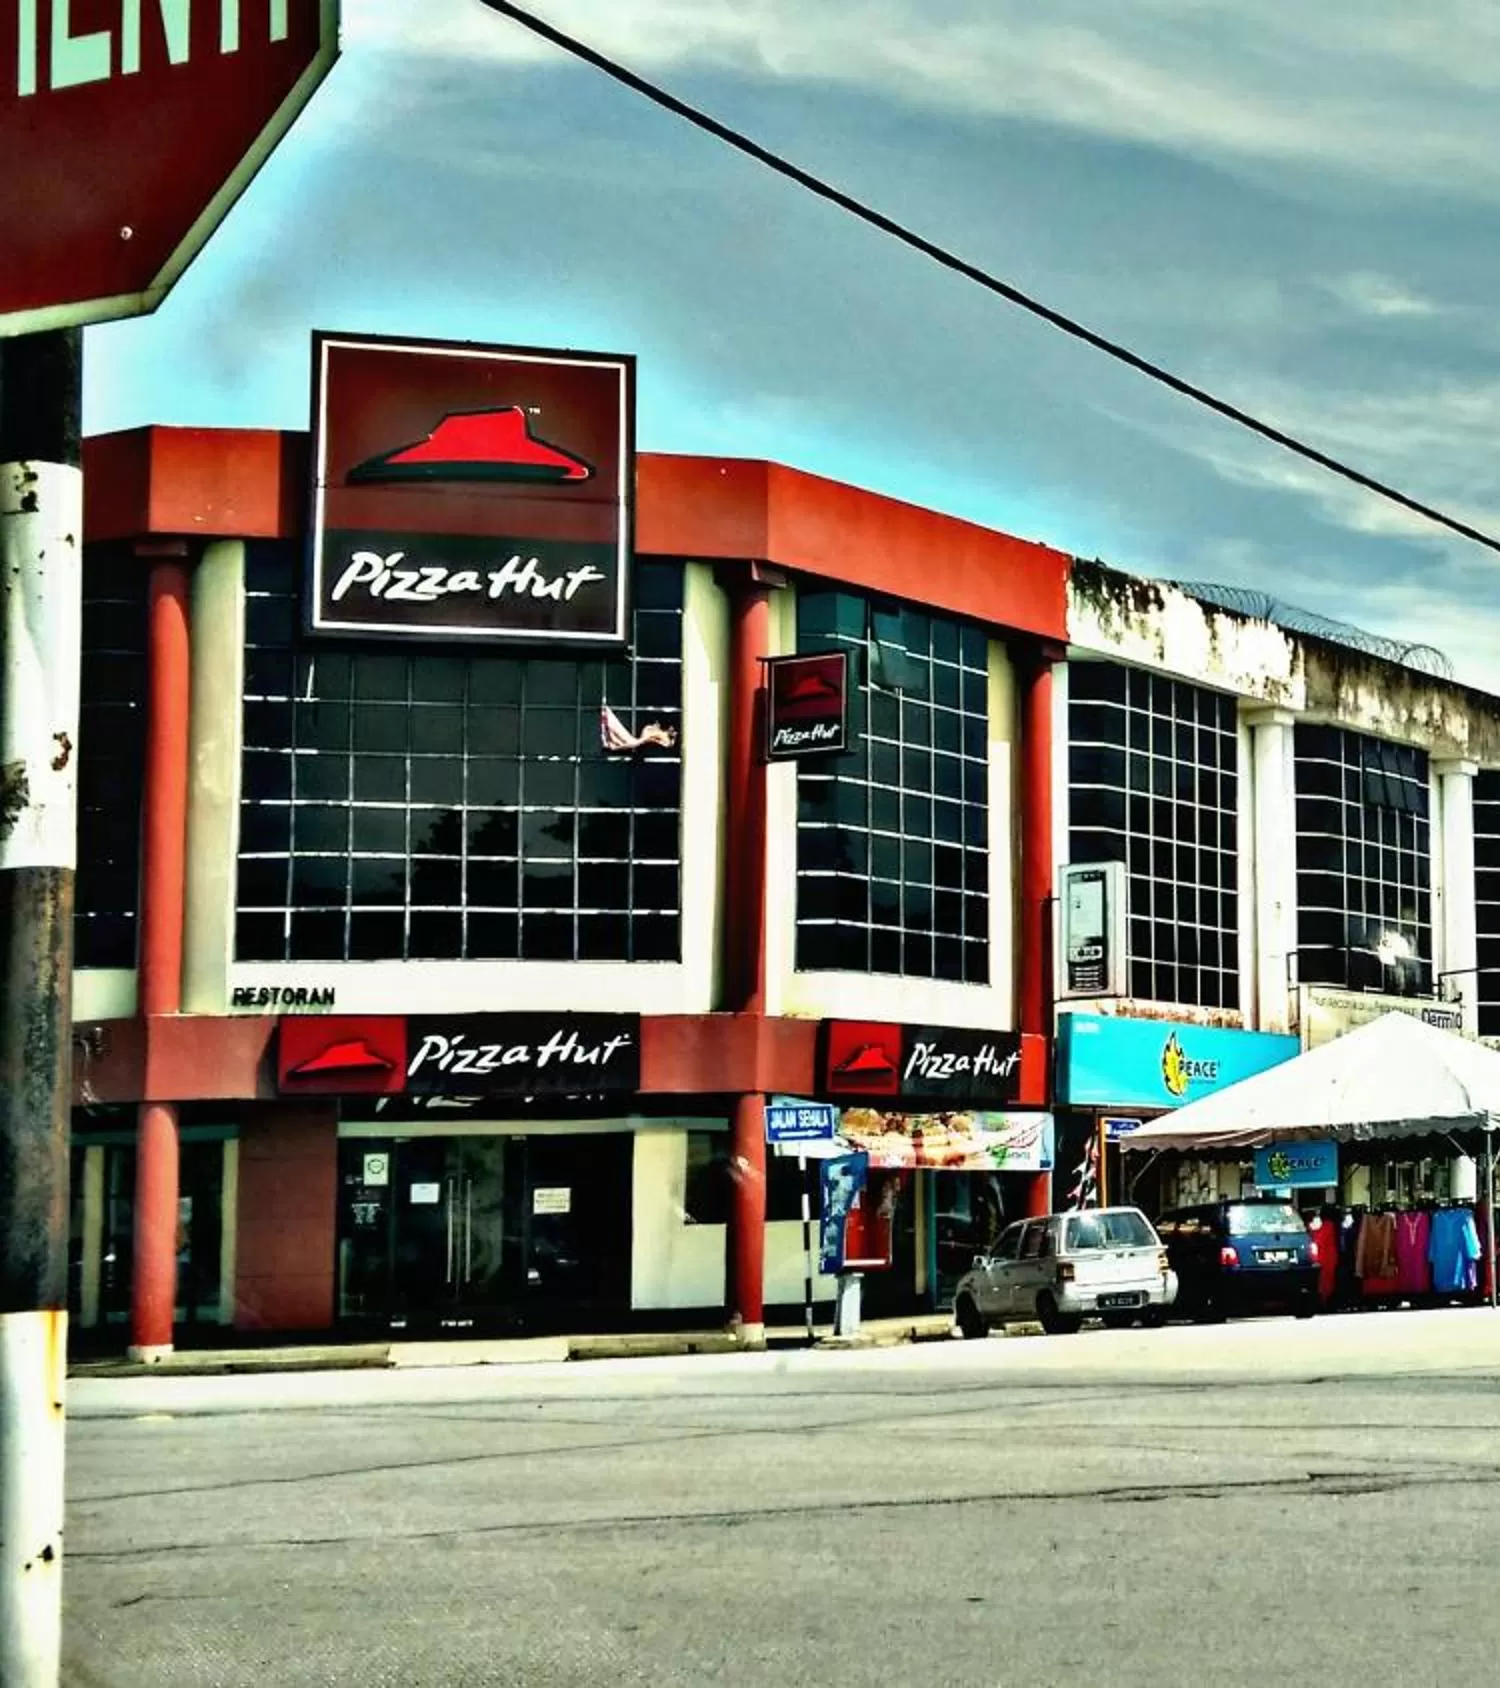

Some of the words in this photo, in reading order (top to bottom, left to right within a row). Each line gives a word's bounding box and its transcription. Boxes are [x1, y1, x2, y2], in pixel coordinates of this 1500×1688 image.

[331, 550, 483, 601] Pizza
[486, 554, 608, 601] Hut
[772, 727, 811, 748] Pizza
[811, 723, 841, 741] Hut
[231, 986, 336, 1006] RESTORAN
[406, 1034, 531, 1077] Pizza
[536, 1029, 633, 1068] Hut
[903, 1042, 971, 1081] Pizza
[973, 1043, 1022, 1078] Hut
[1178, 1059, 1217, 1078] PEACE
[770, 1109, 797, 1129] JALAN
